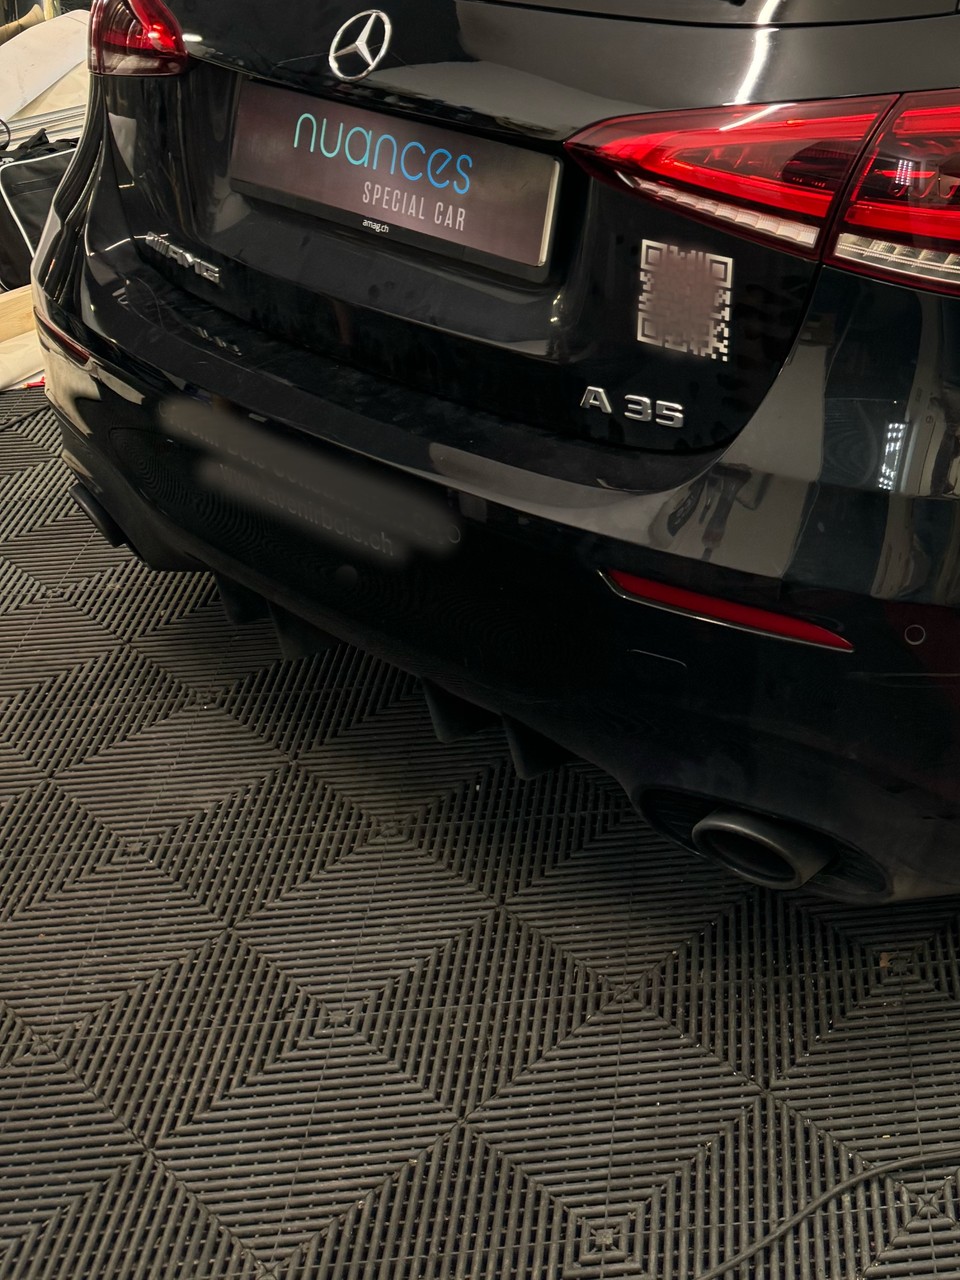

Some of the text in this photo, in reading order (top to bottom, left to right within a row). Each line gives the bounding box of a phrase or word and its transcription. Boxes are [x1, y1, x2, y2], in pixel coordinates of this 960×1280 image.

[293, 112, 473, 195] nuances
[362, 181, 466, 232] SPECIAL CAR
[362, 219, 390, 233] amag.ch
[580, 385, 684, 428] A 35
